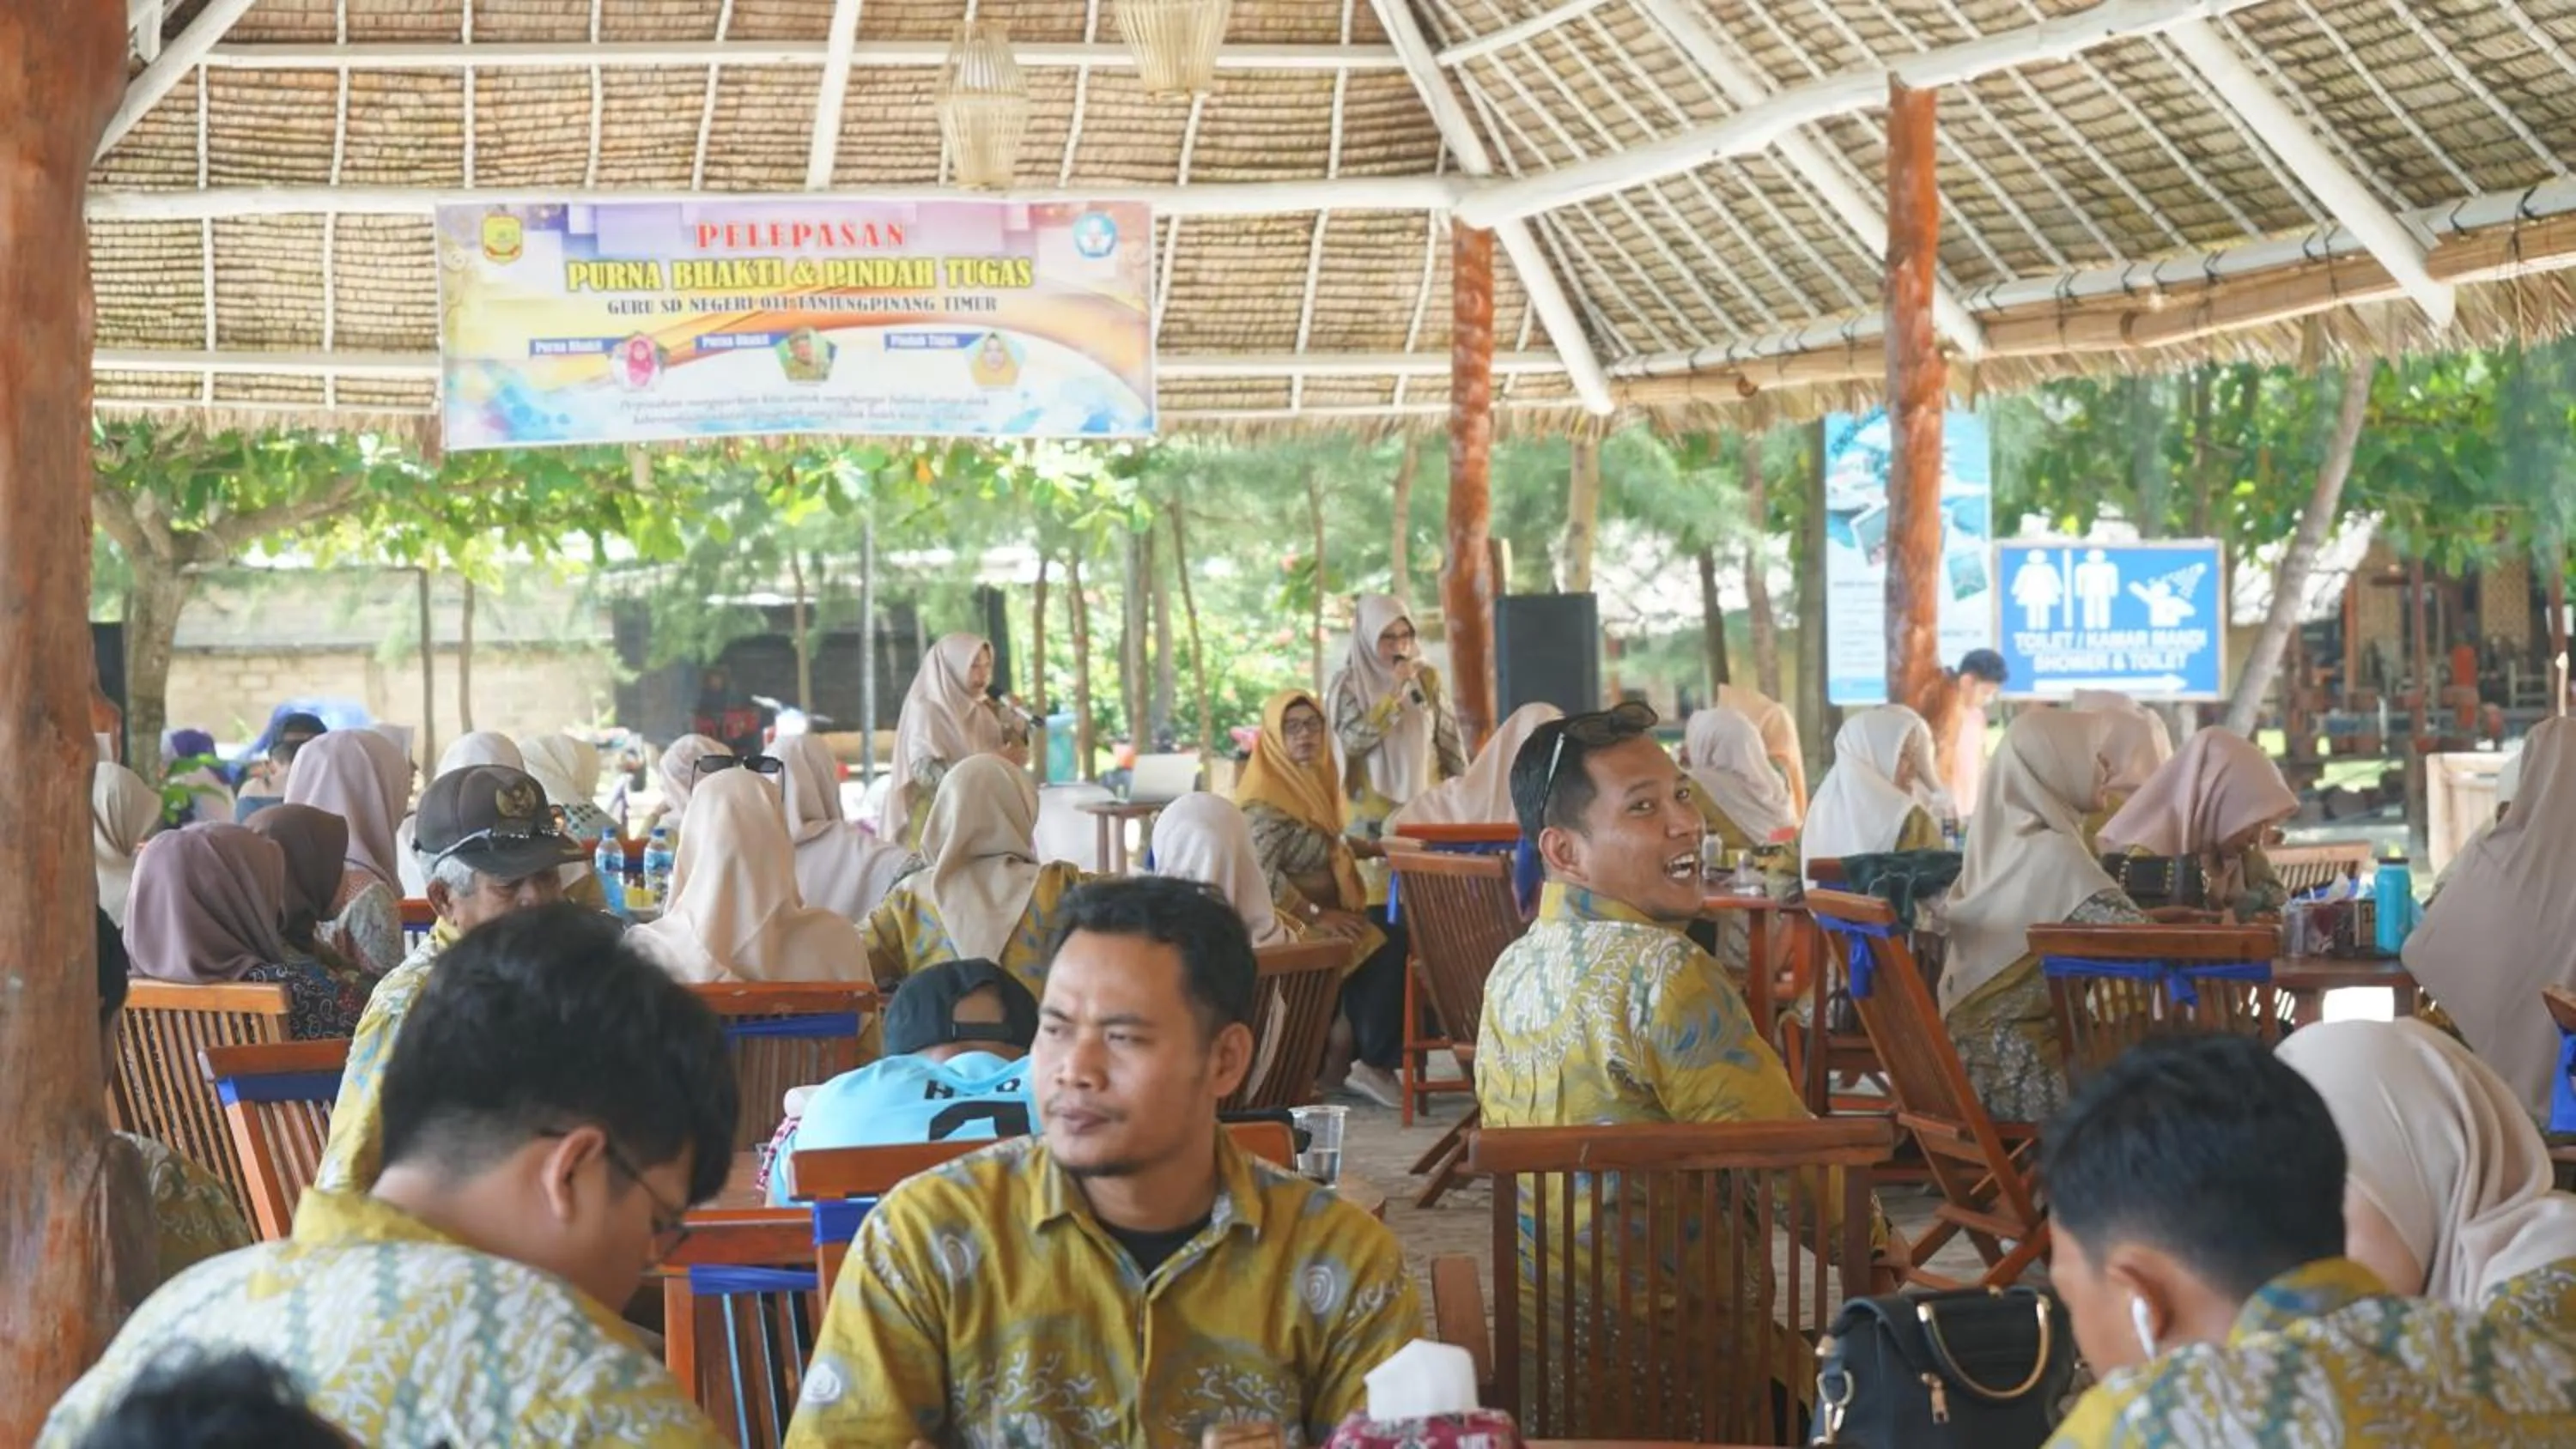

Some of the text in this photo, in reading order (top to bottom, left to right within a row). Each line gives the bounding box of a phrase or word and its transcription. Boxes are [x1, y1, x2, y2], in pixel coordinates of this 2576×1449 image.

[696, 222, 905, 248] PELEPASAN
[566, 257, 1033, 292] PURNA BHAKTI & PINDAH TUGAS
[607, 299, 654, 315] GURU
[660, 298, 683, 314] SD
[689, 295, 755, 312] NEGERI
[944, 296, 999, 312] TIMUR
[2013, 631, 2075, 652] TOILET
[2129, 650, 2189, 670] TOILET
